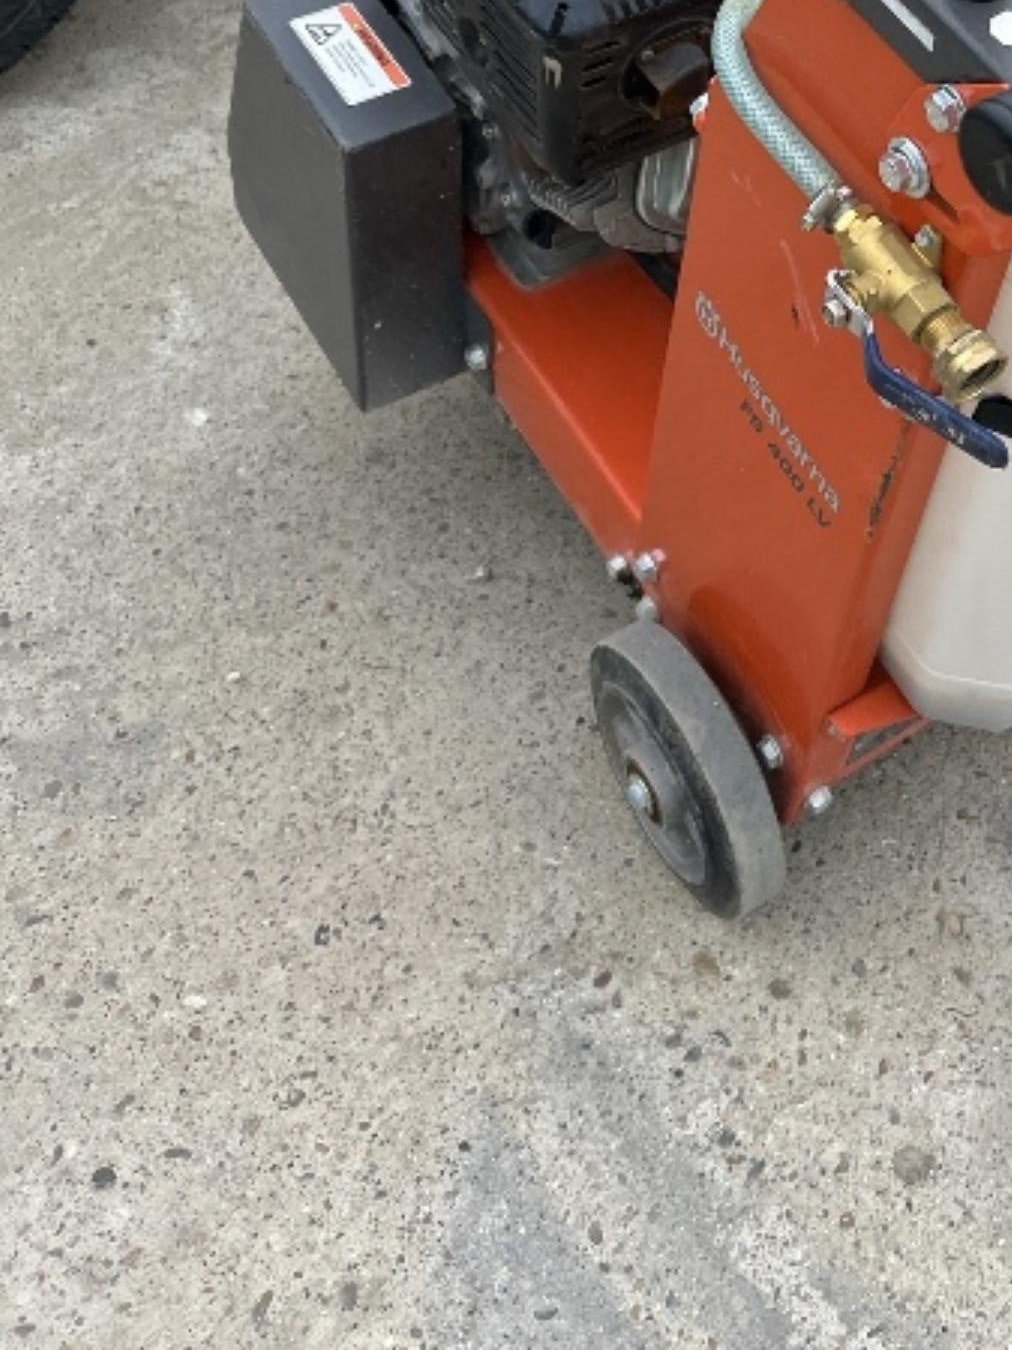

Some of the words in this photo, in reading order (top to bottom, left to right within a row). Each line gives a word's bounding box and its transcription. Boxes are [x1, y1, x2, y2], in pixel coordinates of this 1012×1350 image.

[718, 326, 839, 514] Husqvarna
[767, 442, 804, 493] 400
[806, 497, 832, 527] LV
